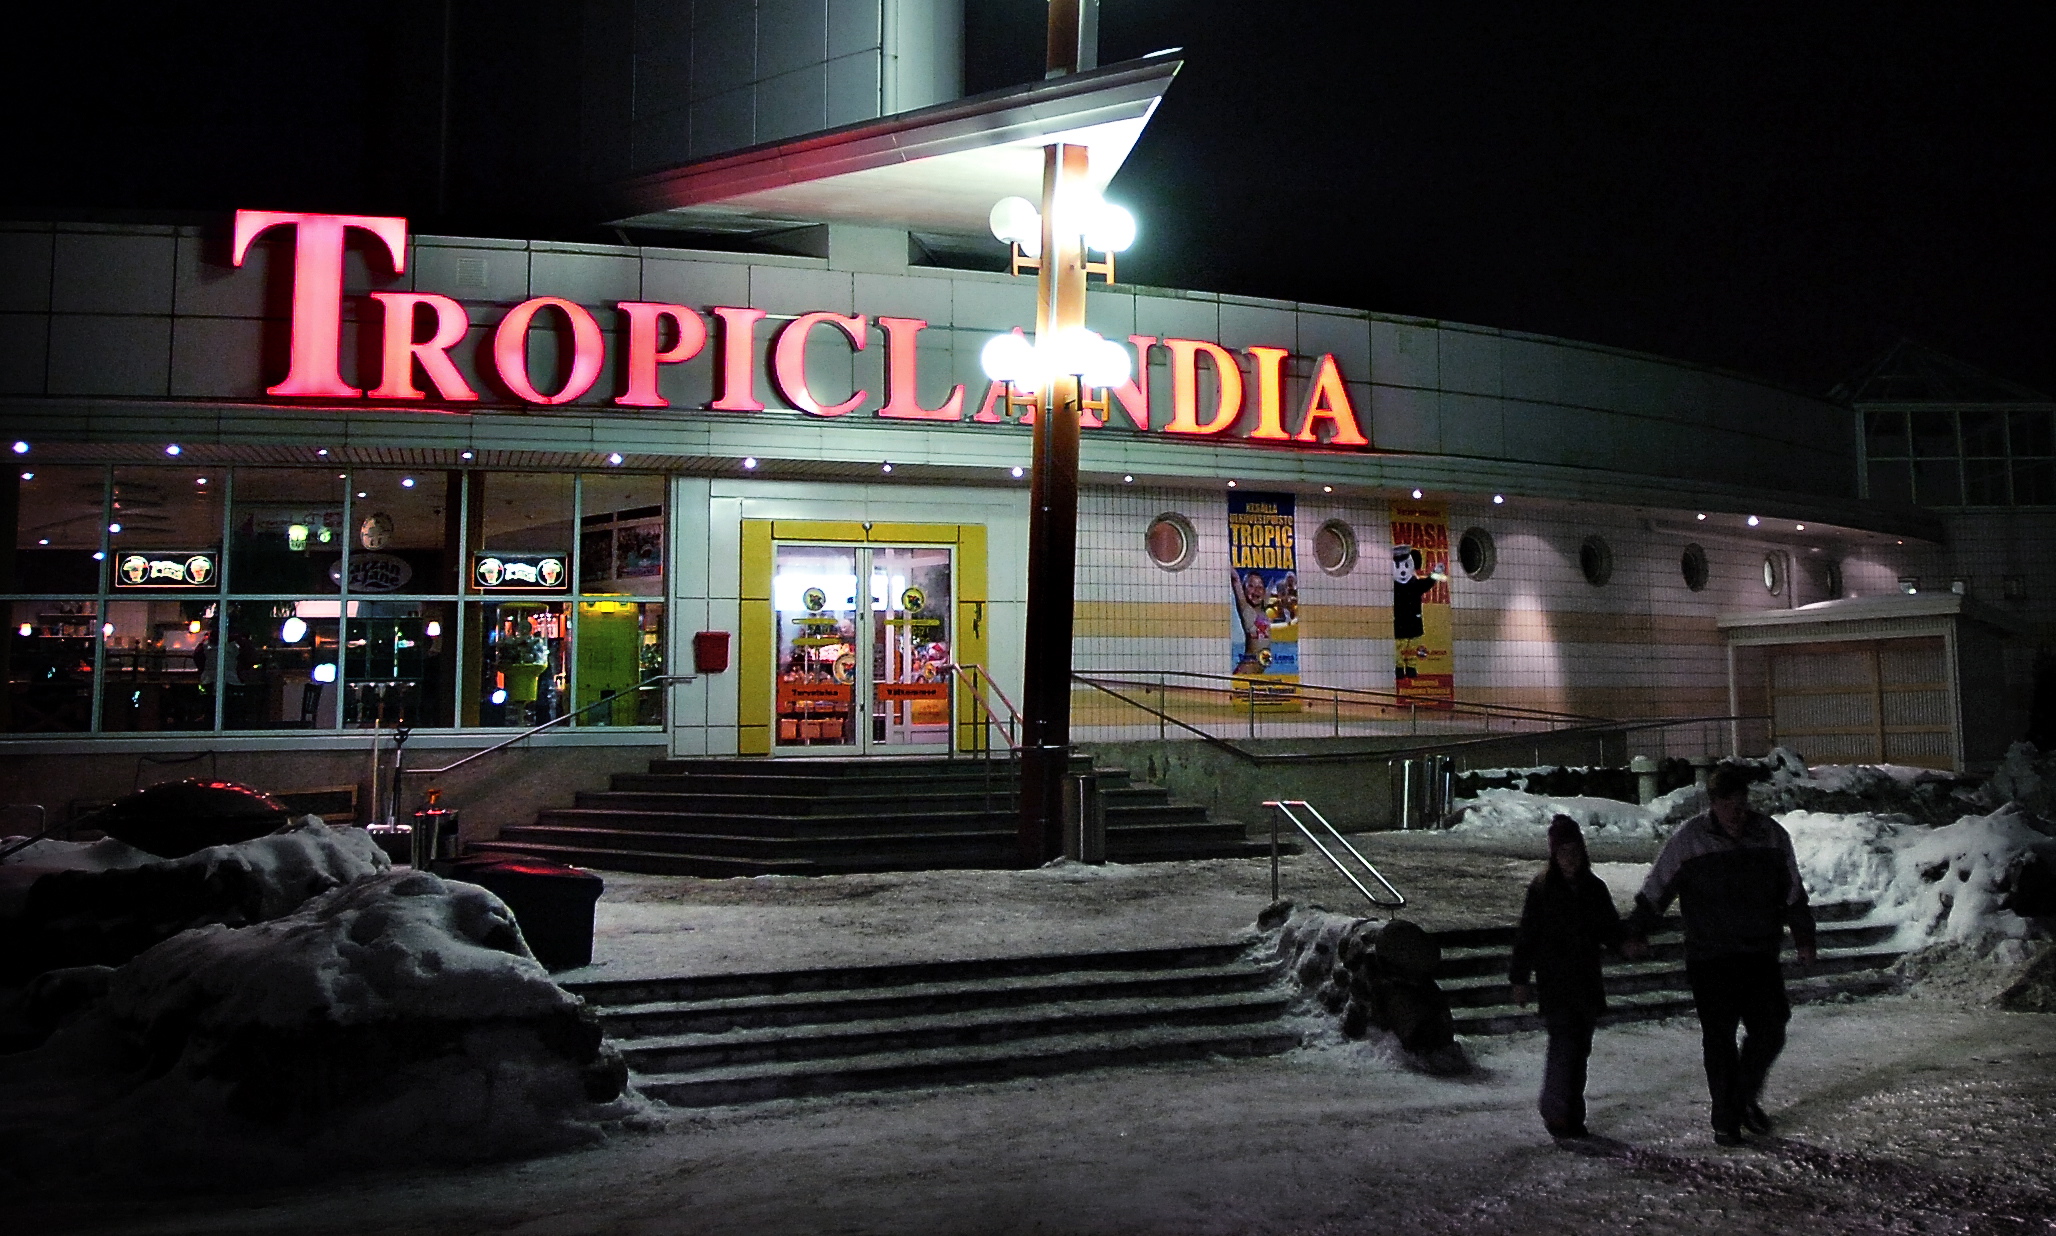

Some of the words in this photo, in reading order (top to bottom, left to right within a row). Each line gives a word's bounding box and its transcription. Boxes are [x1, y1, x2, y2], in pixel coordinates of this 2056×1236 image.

[1230, 524, 1293, 547] TROPIC
[1391, 522, 1448, 549] WASA
[1232, 546, 1294, 569] LANDIA
